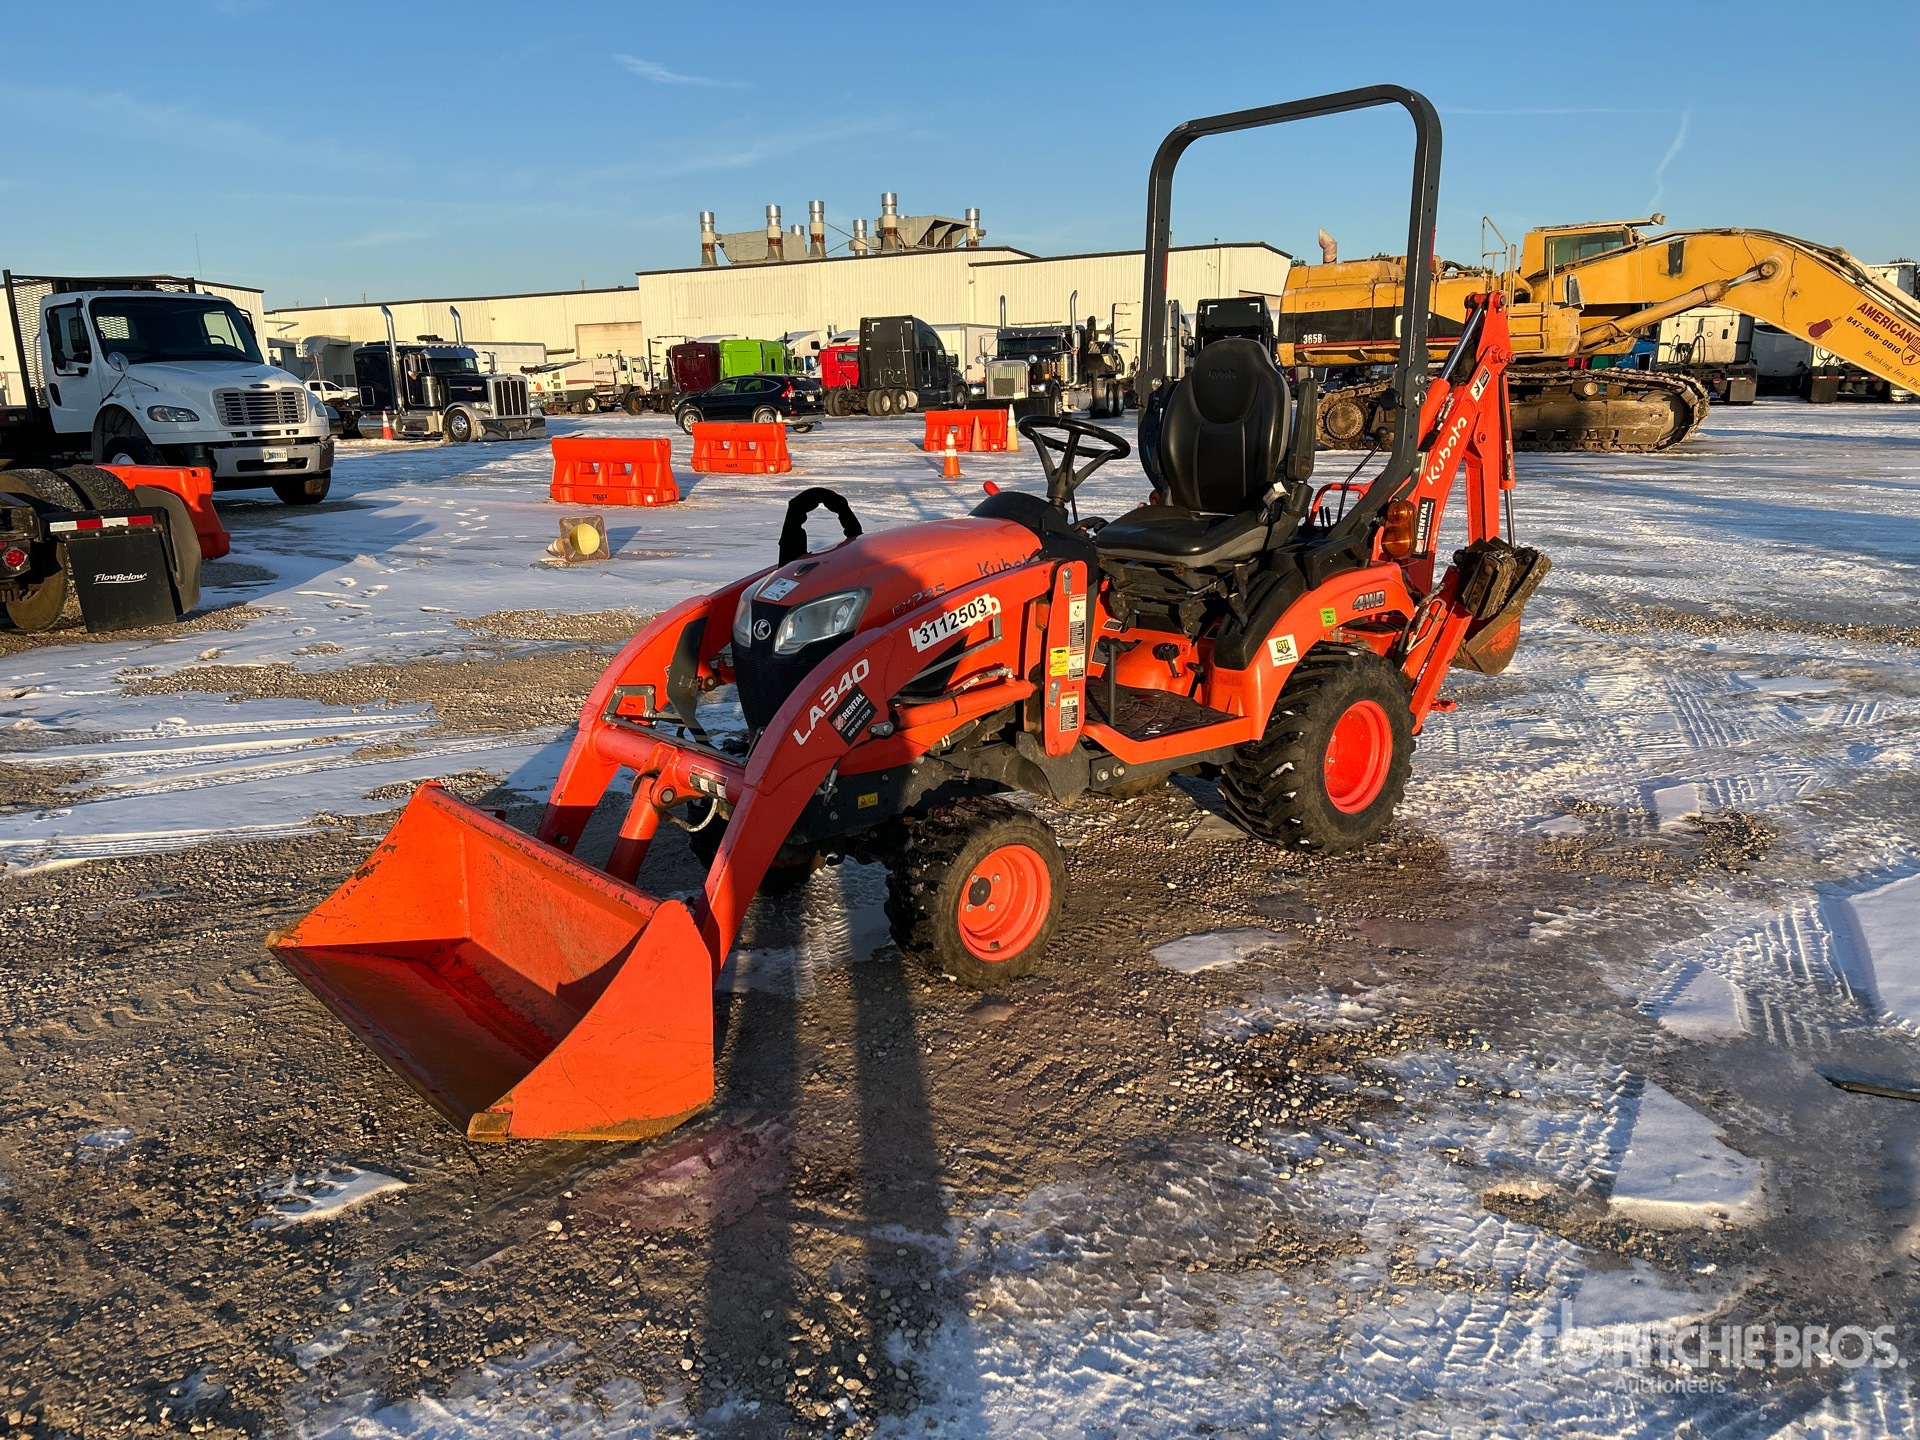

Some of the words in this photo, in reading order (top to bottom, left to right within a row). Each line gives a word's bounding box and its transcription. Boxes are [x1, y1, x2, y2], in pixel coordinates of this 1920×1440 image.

[1846, 316, 1902, 354] 847-608-0010
[1857, 302, 1915, 343] AMERICAN
[1303, 333, 1322, 344] 365B
[1208, 369, 1237, 380] Kubota
[1864, 350, 1893, 371] Breaking
[1893, 368, 1907, 379] Into
[1426, 416, 1467, 485] Kubota
[1416, 501, 1429, 539] RENTAL
[93, 572, 147, 582] FlowBelow
[977, 554, 1029, 577] Kubot
[1352, 590, 1385, 612] 4WD
[919, 598, 987, 644] 3112503
[1276, 640, 1289, 650] 811
[793, 659, 870, 746] LA340
[842, 694, 865, 720] RENTAL
